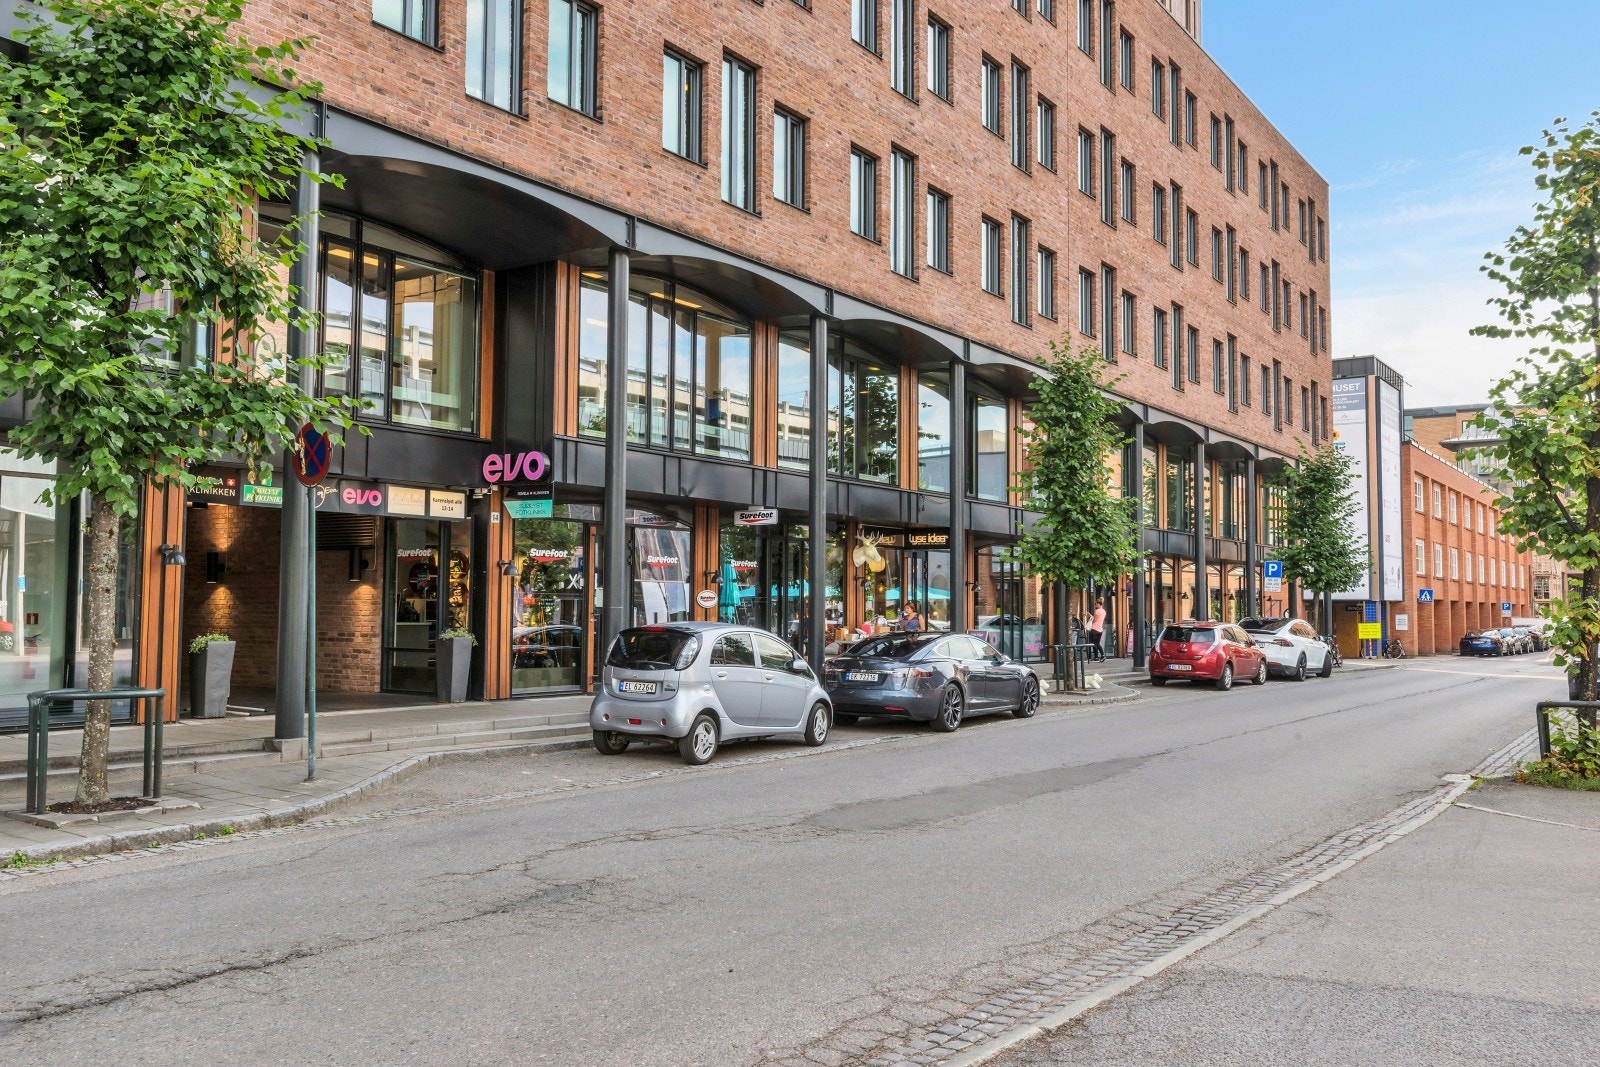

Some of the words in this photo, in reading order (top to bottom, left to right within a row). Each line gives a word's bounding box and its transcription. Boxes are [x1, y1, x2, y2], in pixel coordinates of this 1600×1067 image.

[483, 451, 544, 482] evo
[190, 486, 236, 497] KLINIKKEN
[342, 487, 382, 507] evo
[492, 513, 499, 521] 14
[739, 511, 774, 520] Surefoot
[927, 533, 949, 543] ideer
[397, 548, 432, 557] Surefoot
[530, 548, 568, 558] Surefoot
[647, 555, 678, 565] Surefoot
[731, 559, 758, 568] Surefoot
[1268, 563, 1278, 576] P
[624, 682, 632, 690] EL
[633, 682, 654, 692] 62264
